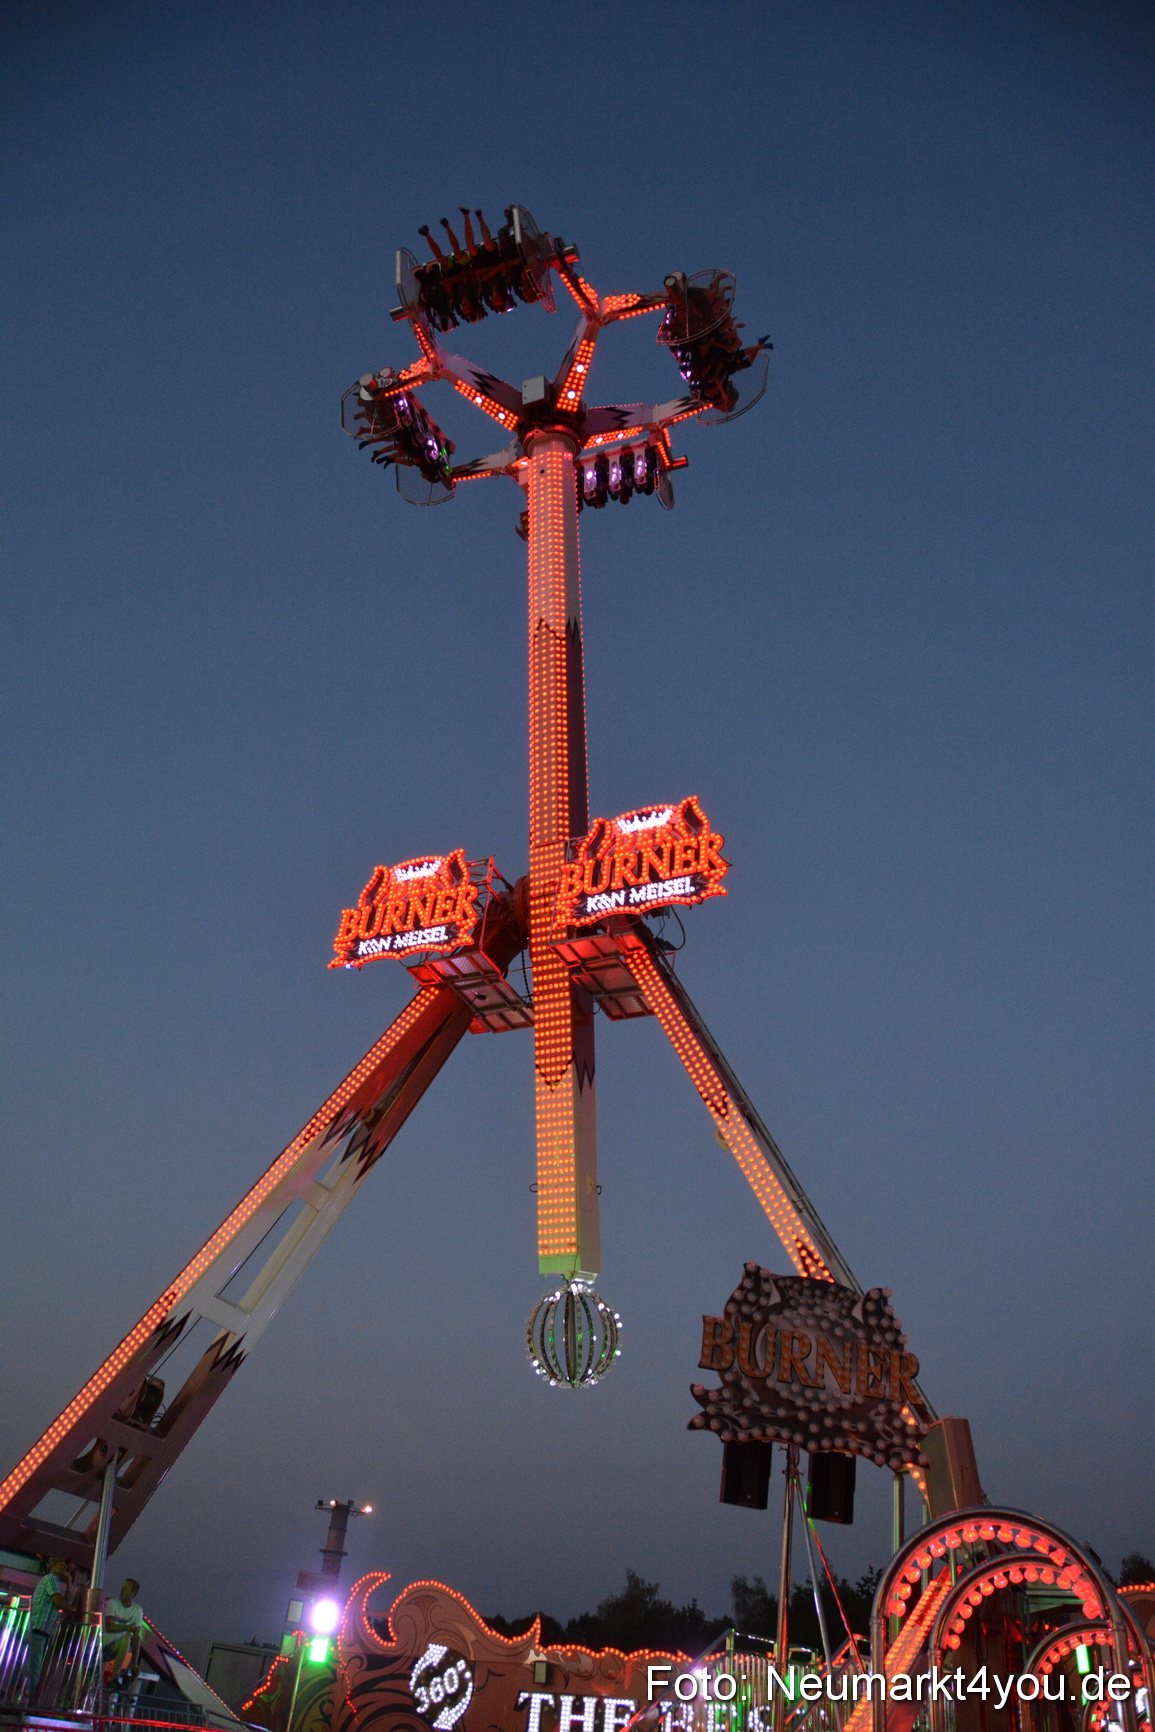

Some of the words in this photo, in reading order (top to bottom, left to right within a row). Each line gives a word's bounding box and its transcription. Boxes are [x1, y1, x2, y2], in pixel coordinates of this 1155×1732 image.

[557, 832, 729, 901] BURNER
[629, 876, 695, 904] MEISEL
[334, 885, 479, 943] BURNER
[698, 1315, 925, 1405] BURNER
[517, 1691, 636, 1732] THE
